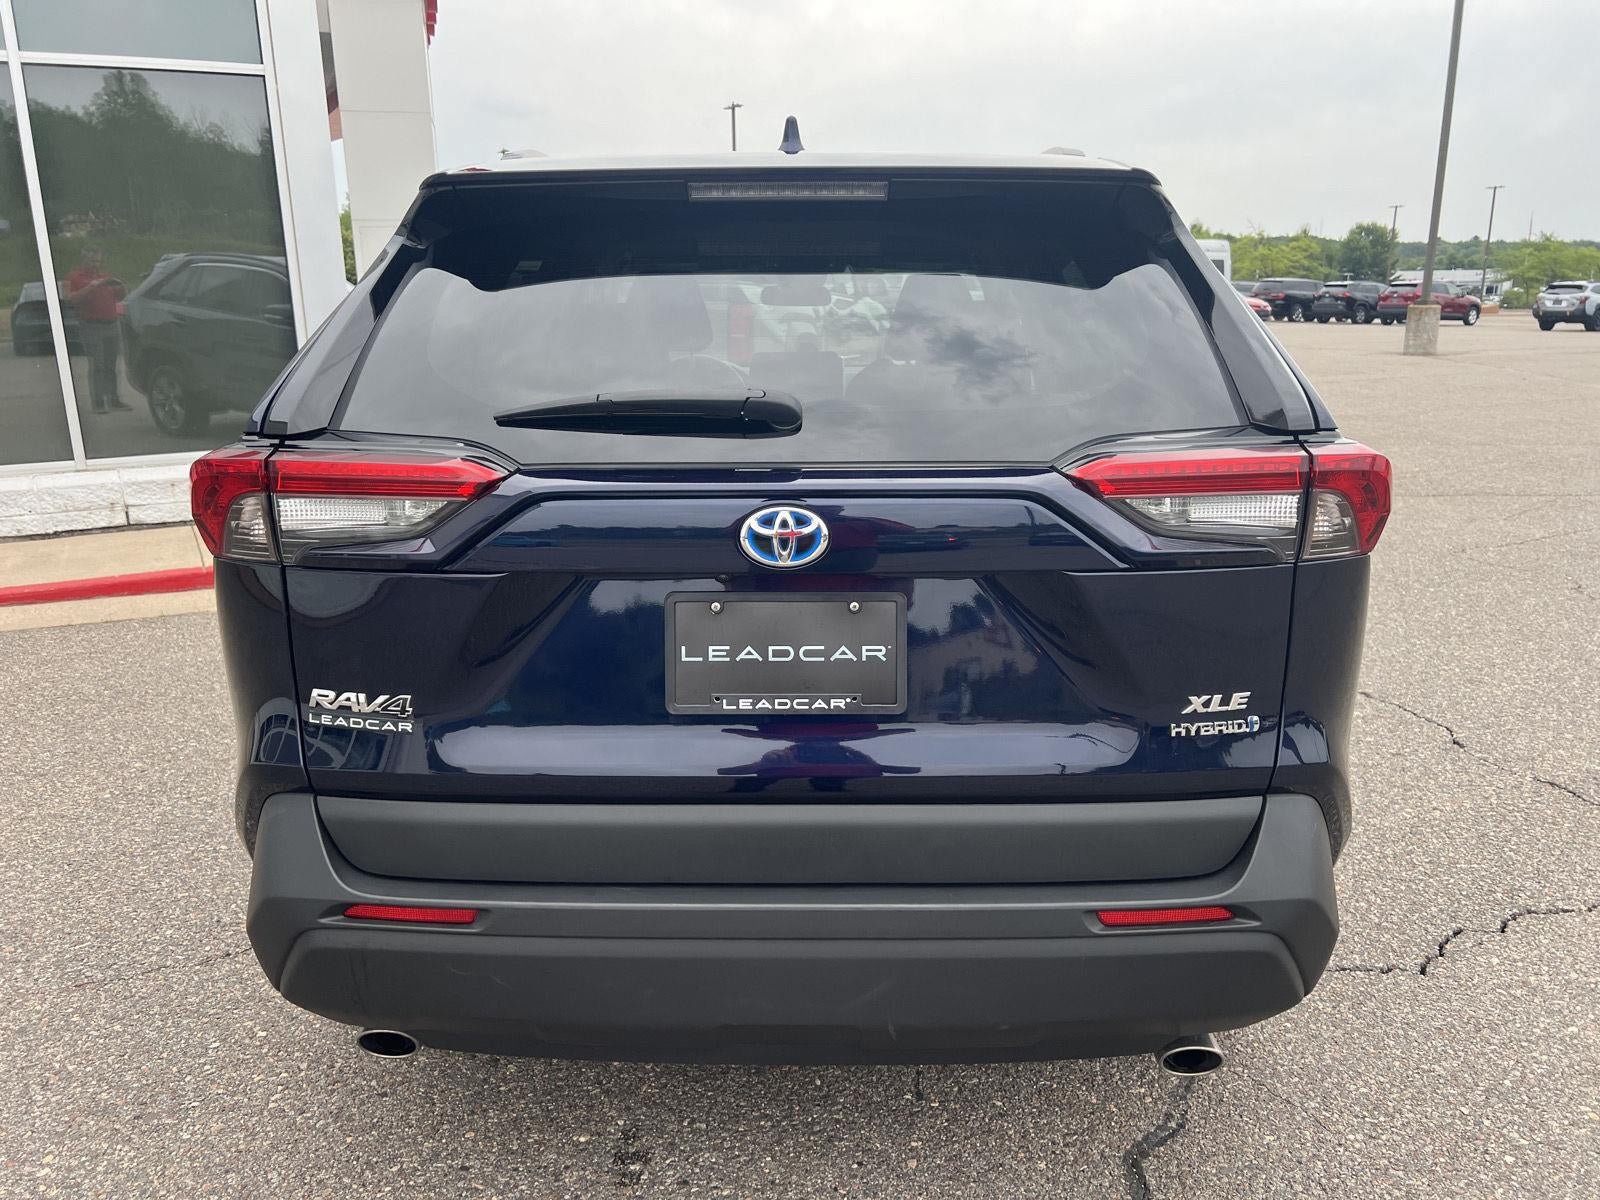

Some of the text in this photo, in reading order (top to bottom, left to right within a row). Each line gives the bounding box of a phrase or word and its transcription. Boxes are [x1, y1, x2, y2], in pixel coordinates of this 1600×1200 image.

[681, 645, 889, 662] LEADCAR
[308, 688, 413, 717] RAV4
[722, 698, 848, 710] LEADCAR
[1181, 691, 1251, 715] XLE
[308, 713, 413, 732] LEADCAR
[1170, 719, 1247, 737] HYBRID
